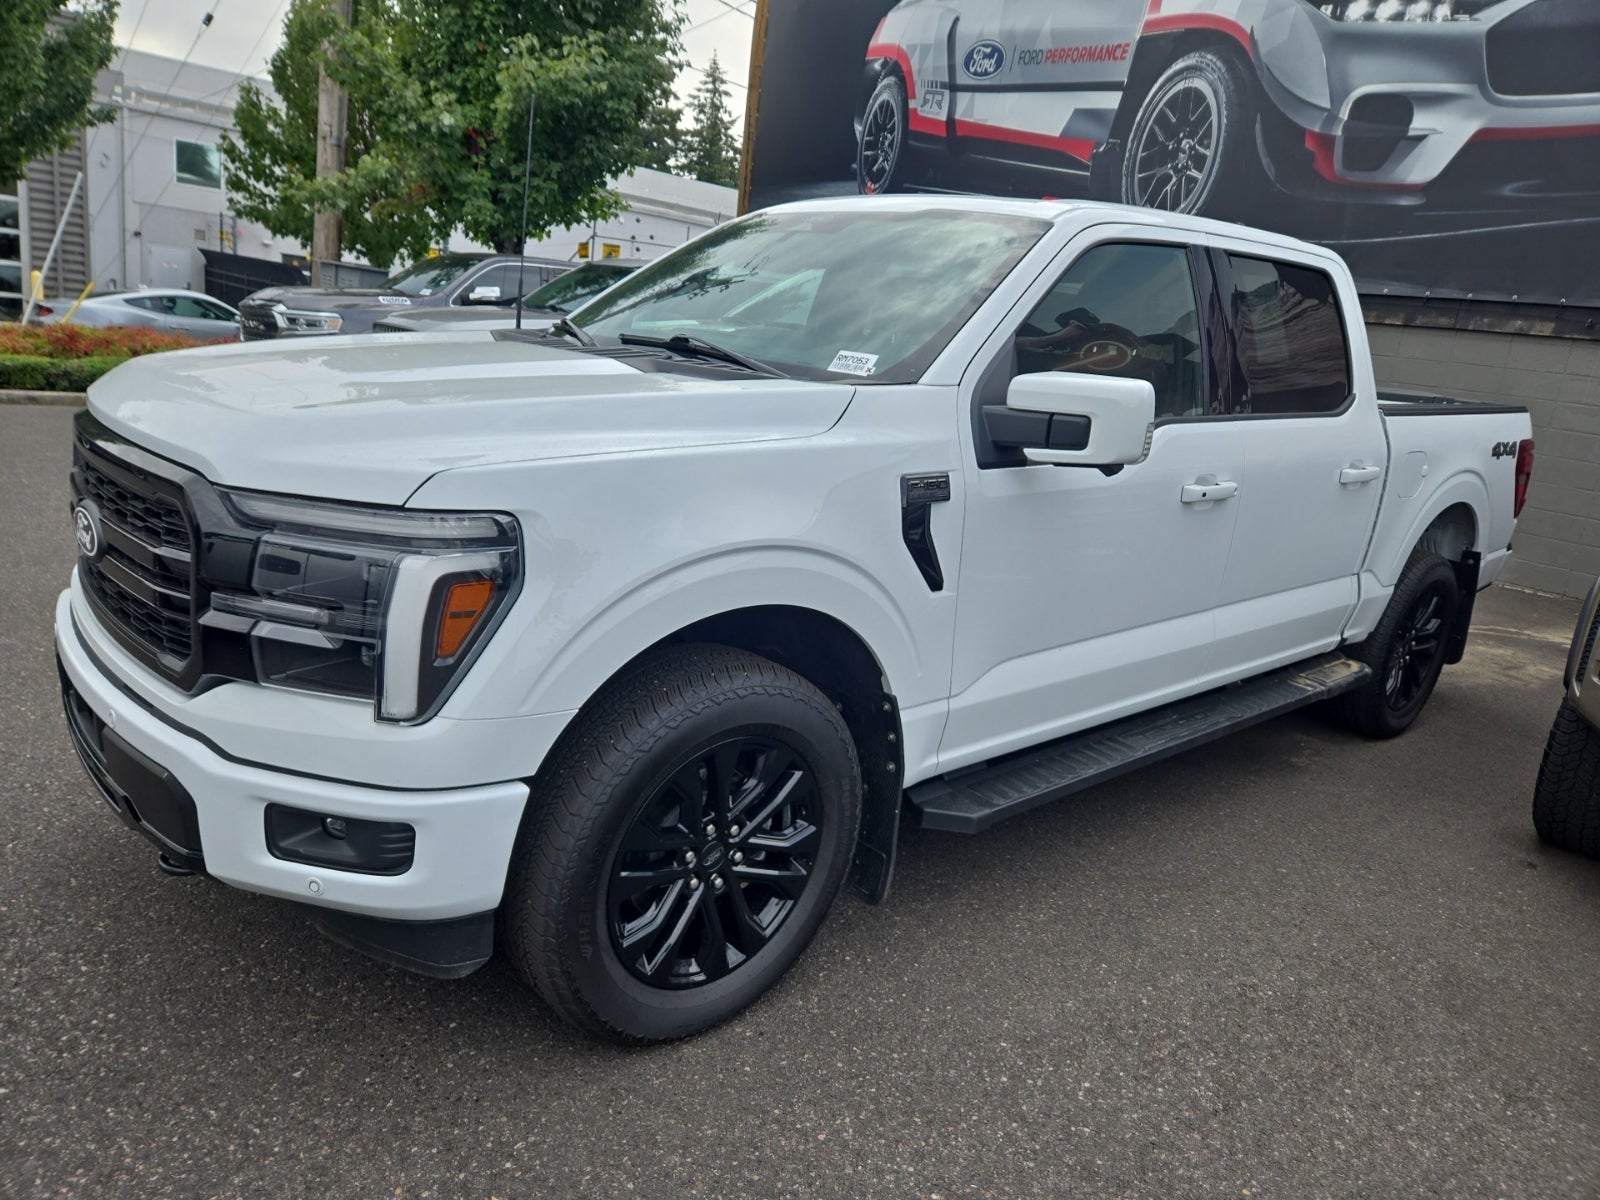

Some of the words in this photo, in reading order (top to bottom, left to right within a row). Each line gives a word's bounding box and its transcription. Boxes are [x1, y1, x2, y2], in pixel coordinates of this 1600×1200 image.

[969, 46, 999, 74] Ford
[1018, 50, 1043, 66] FORD
[1045, 43, 1131, 64] PERFORMANCE
[76, 512, 92, 551] Ford
